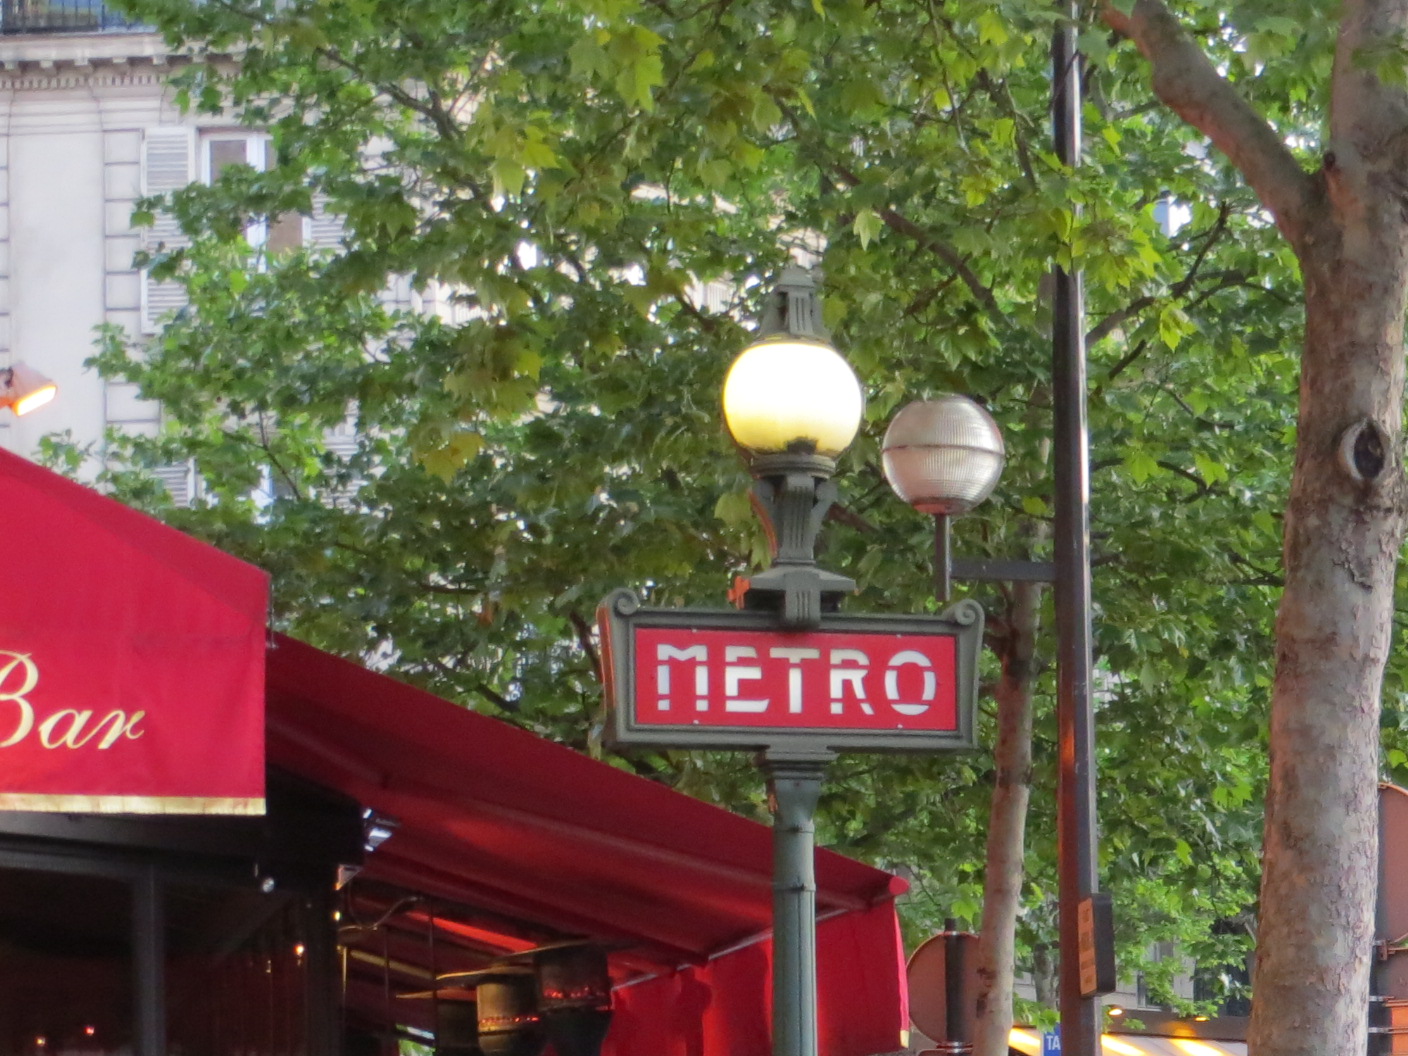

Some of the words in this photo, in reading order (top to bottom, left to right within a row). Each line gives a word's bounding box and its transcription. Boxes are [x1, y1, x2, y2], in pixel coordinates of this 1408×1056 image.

[0, 650, 146, 750] Bar
[656, 643, 937, 717] METRO
[1046, 1035, 1061, 1051] TA
